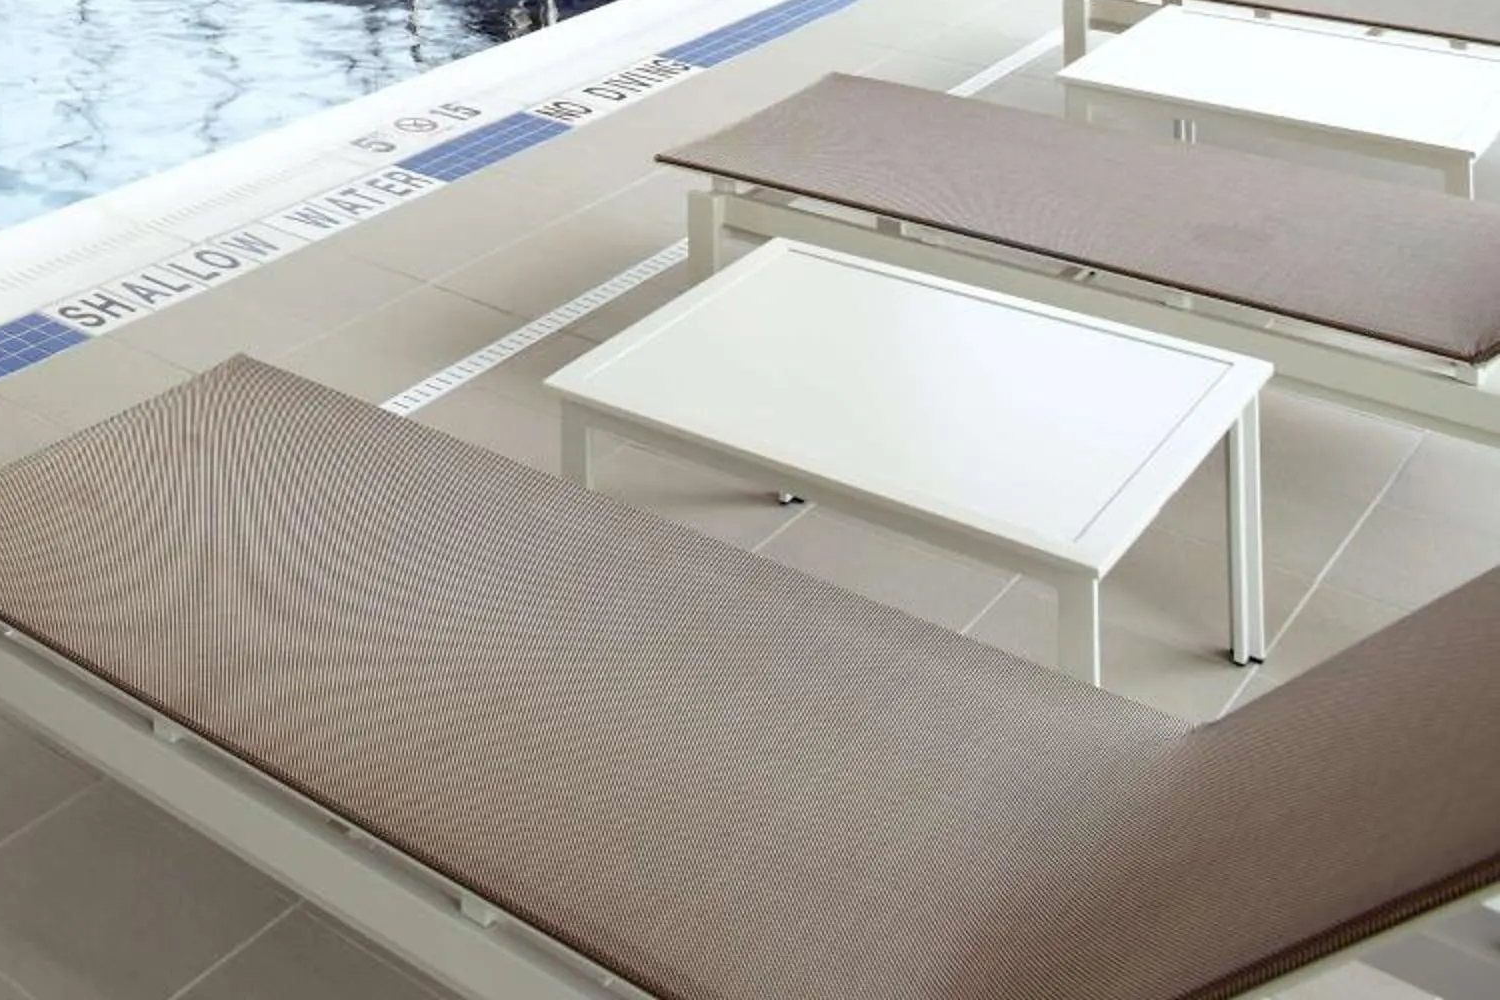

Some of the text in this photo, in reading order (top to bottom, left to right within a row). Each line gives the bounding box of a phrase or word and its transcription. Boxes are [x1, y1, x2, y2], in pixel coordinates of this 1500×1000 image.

[535, 59, 690, 121] NO DIVING
[351, 136, 397, 153] 5
[58, 171, 434, 328] SHALLOW WATER
